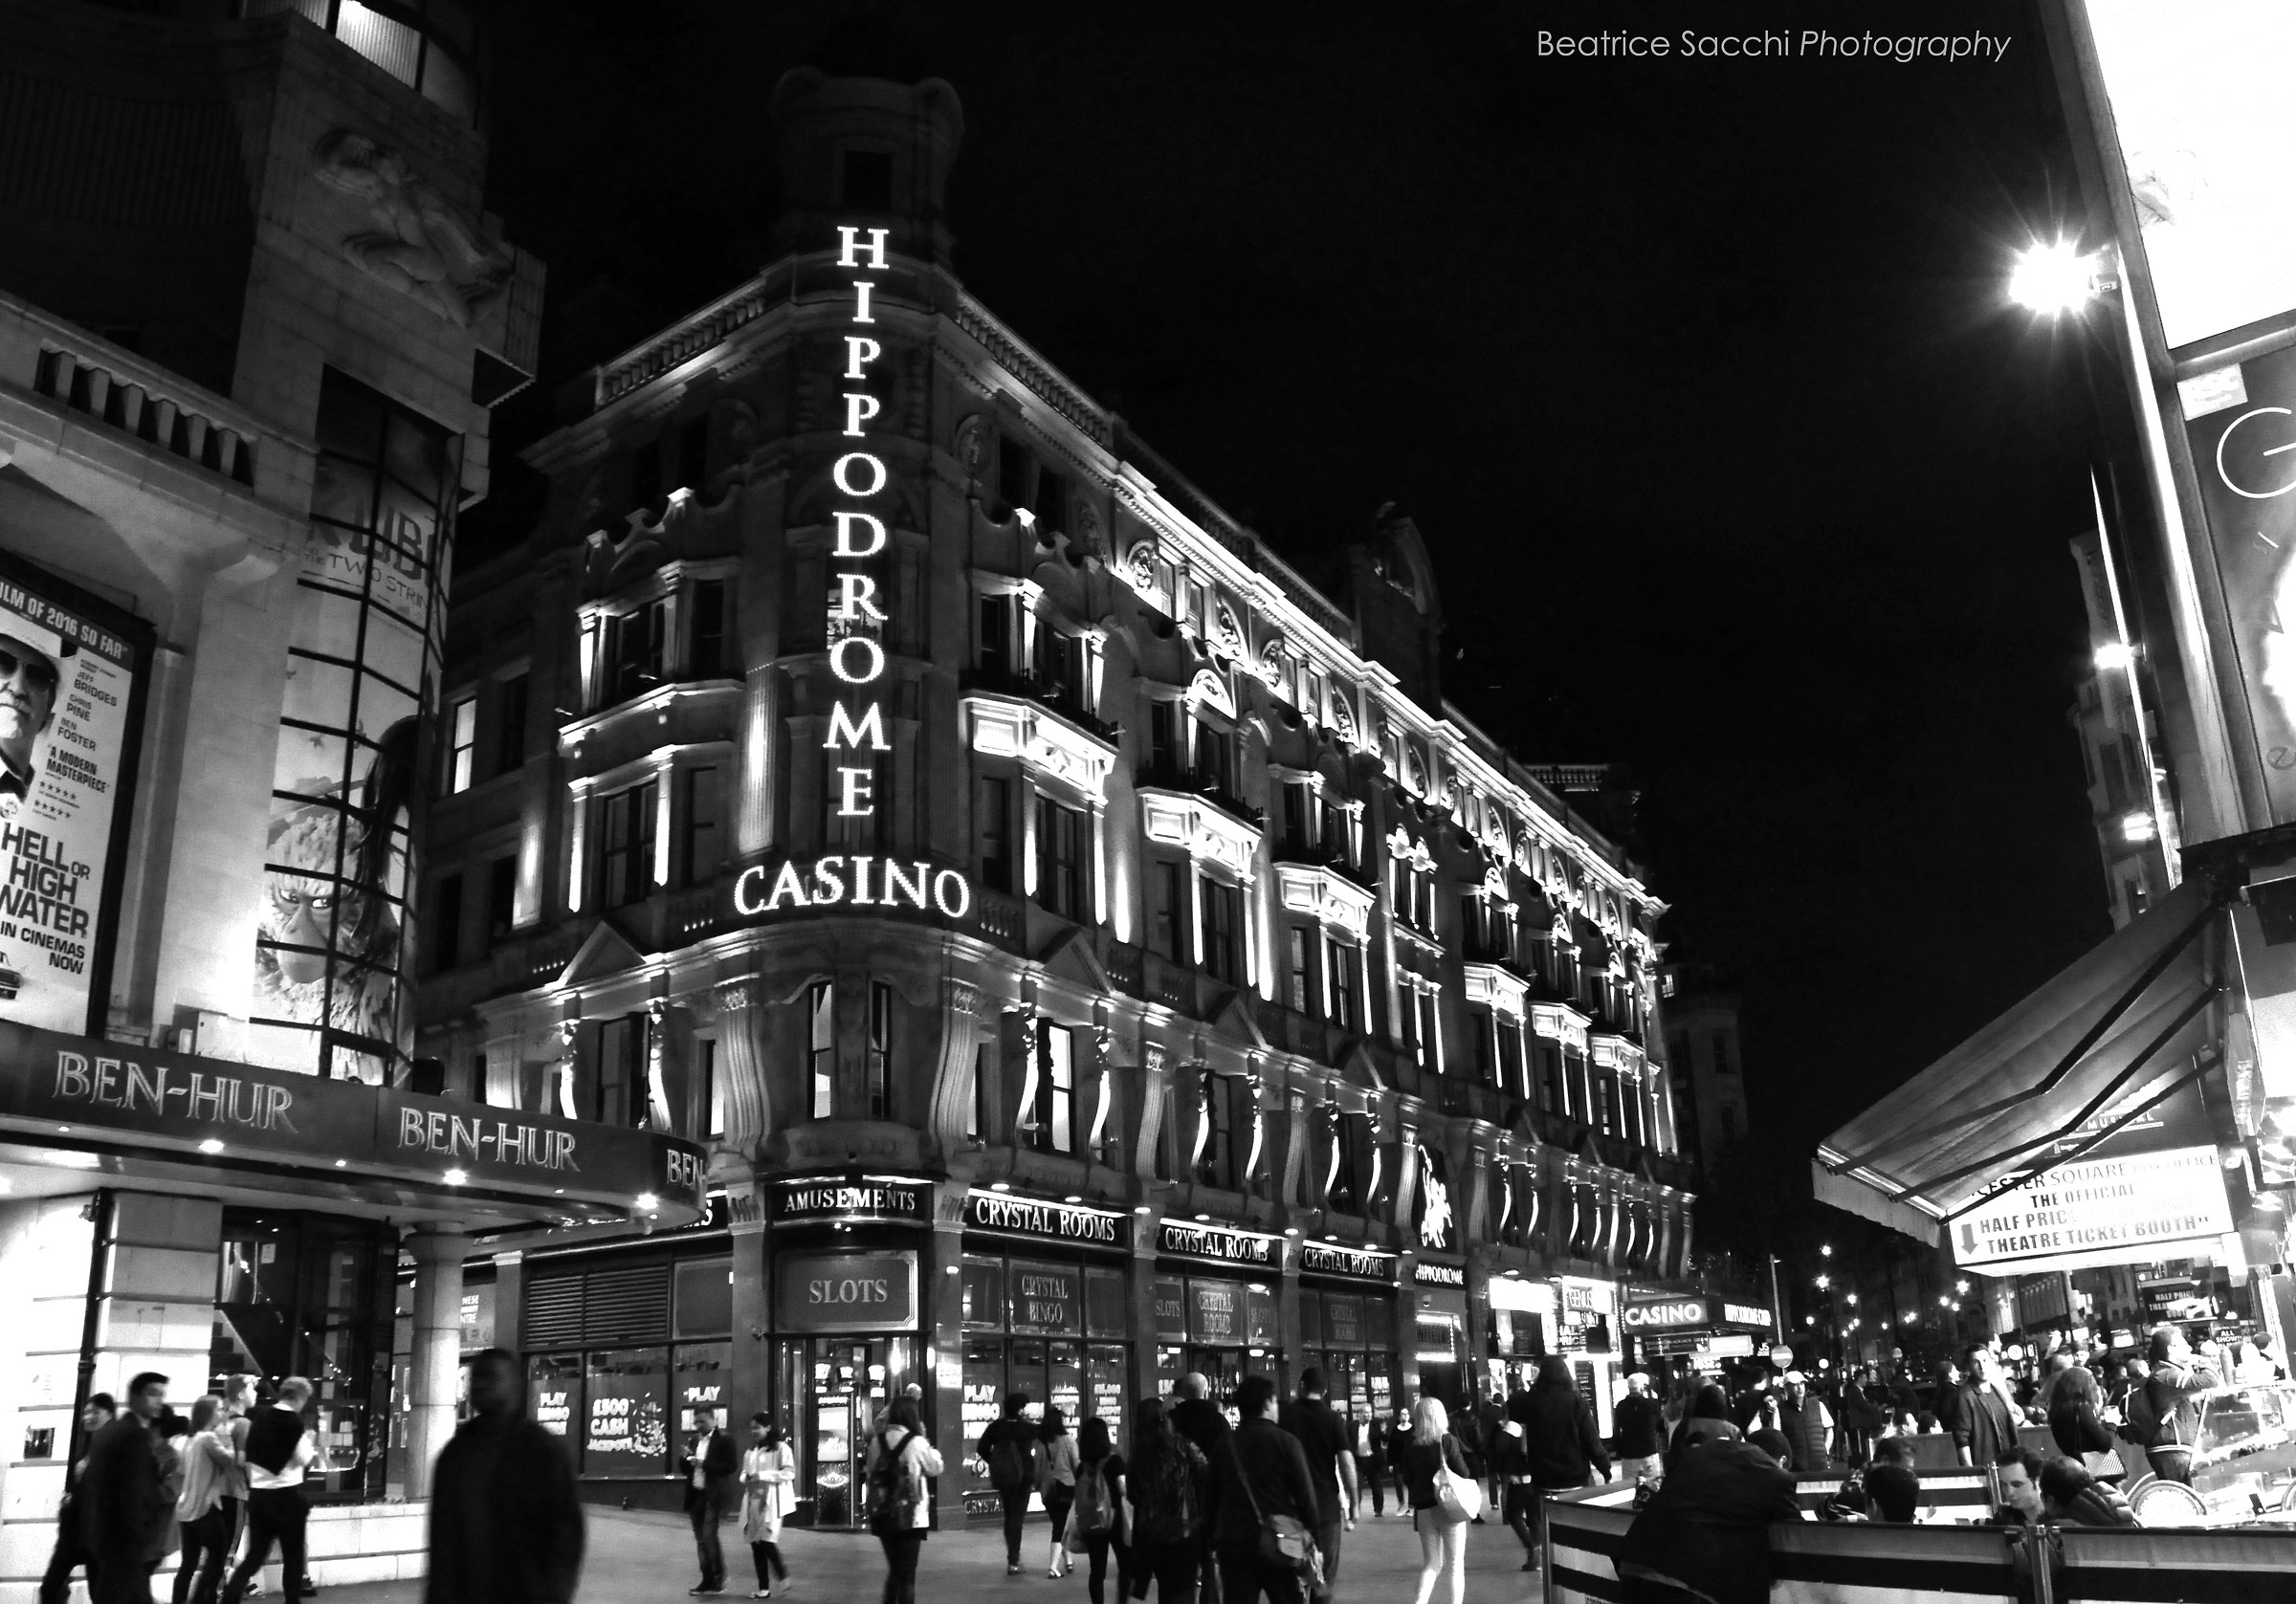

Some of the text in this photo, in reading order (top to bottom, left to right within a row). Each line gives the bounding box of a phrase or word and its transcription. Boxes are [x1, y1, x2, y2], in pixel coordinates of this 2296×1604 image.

[822, 225, 892, 817] HIPPODROME
[327, 553, 383, 582] TWO
[27, 597, 45, 619] OF
[46, 607, 77, 636] 2016
[80, 625, 98, 647] SO
[77, 671, 94, 682] JEFF
[69, 693, 92, 710] CHRIS
[74, 678, 118, 707] BRIDGES
[60, 717, 77, 730] BEN
[66, 702, 91, 722] PINE
[57, 726, 97, 751] FOSTER
[58, 749, 98, 776] MODERN
[2, 821, 90, 880] HELL OR
[10, 855, 78, 905] HIGH
[733, 854, 971, 919] CASINO
[0, 884, 89, 938] WATER
[0, 920, 86, 959] IN CINEMAS
[49, 952, 84, 975] NOW
[52, 1050, 299, 1134] BEN-HUR
[397, 1106, 583, 1174] BEN-HUR
[2049, 1161, 2128, 1188] SQUARE
[784, 1186, 916, 1213] AMUSEMENTS
[2030, 1182, 2135, 1209] THE OFFICIAL
[976, 1198, 1115, 1241] CRYSTAL ROOMS
[1978, 1209, 2077, 1235] HALF PRIC
[1165, 1226, 1268, 1262] CRYSTAL ROOMS
[1987, 1229, 2062, 1254] THEATRE
[2065, 1222, 2130, 1245] TICKET
[1304, 1247, 1384, 1277] CRYSTAL ROOMS
[1415, 1263, 1464, 1285] HIPPODROME
[808, 1279, 888, 1304] SLOTS
[1022, 1274, 1069, 1299] CRYSTAL
[2154, 1292, 2173, 1302] HALF
[1028, 1301, 1064, 1324] BINGO
[1156, 1299, 1181, 1318] SLOTS
[1198, 1290, 1234, 1312] CRYSTAL
[1203, 1313, 1232, 1335] ROOMS
[1624, 1303, 1702, 1327] CASINO
[540, 1392, 567, 1407] PLAY
[688, 1386, 721, 1402] PLAY
[963, 1384, 997, 1402] PLAY
[961, 1402, 1001, 1421] BINGO
[590, 1417, 629, 1436] CASH
[964, 1498, 1004, 1514] CRYSTA
